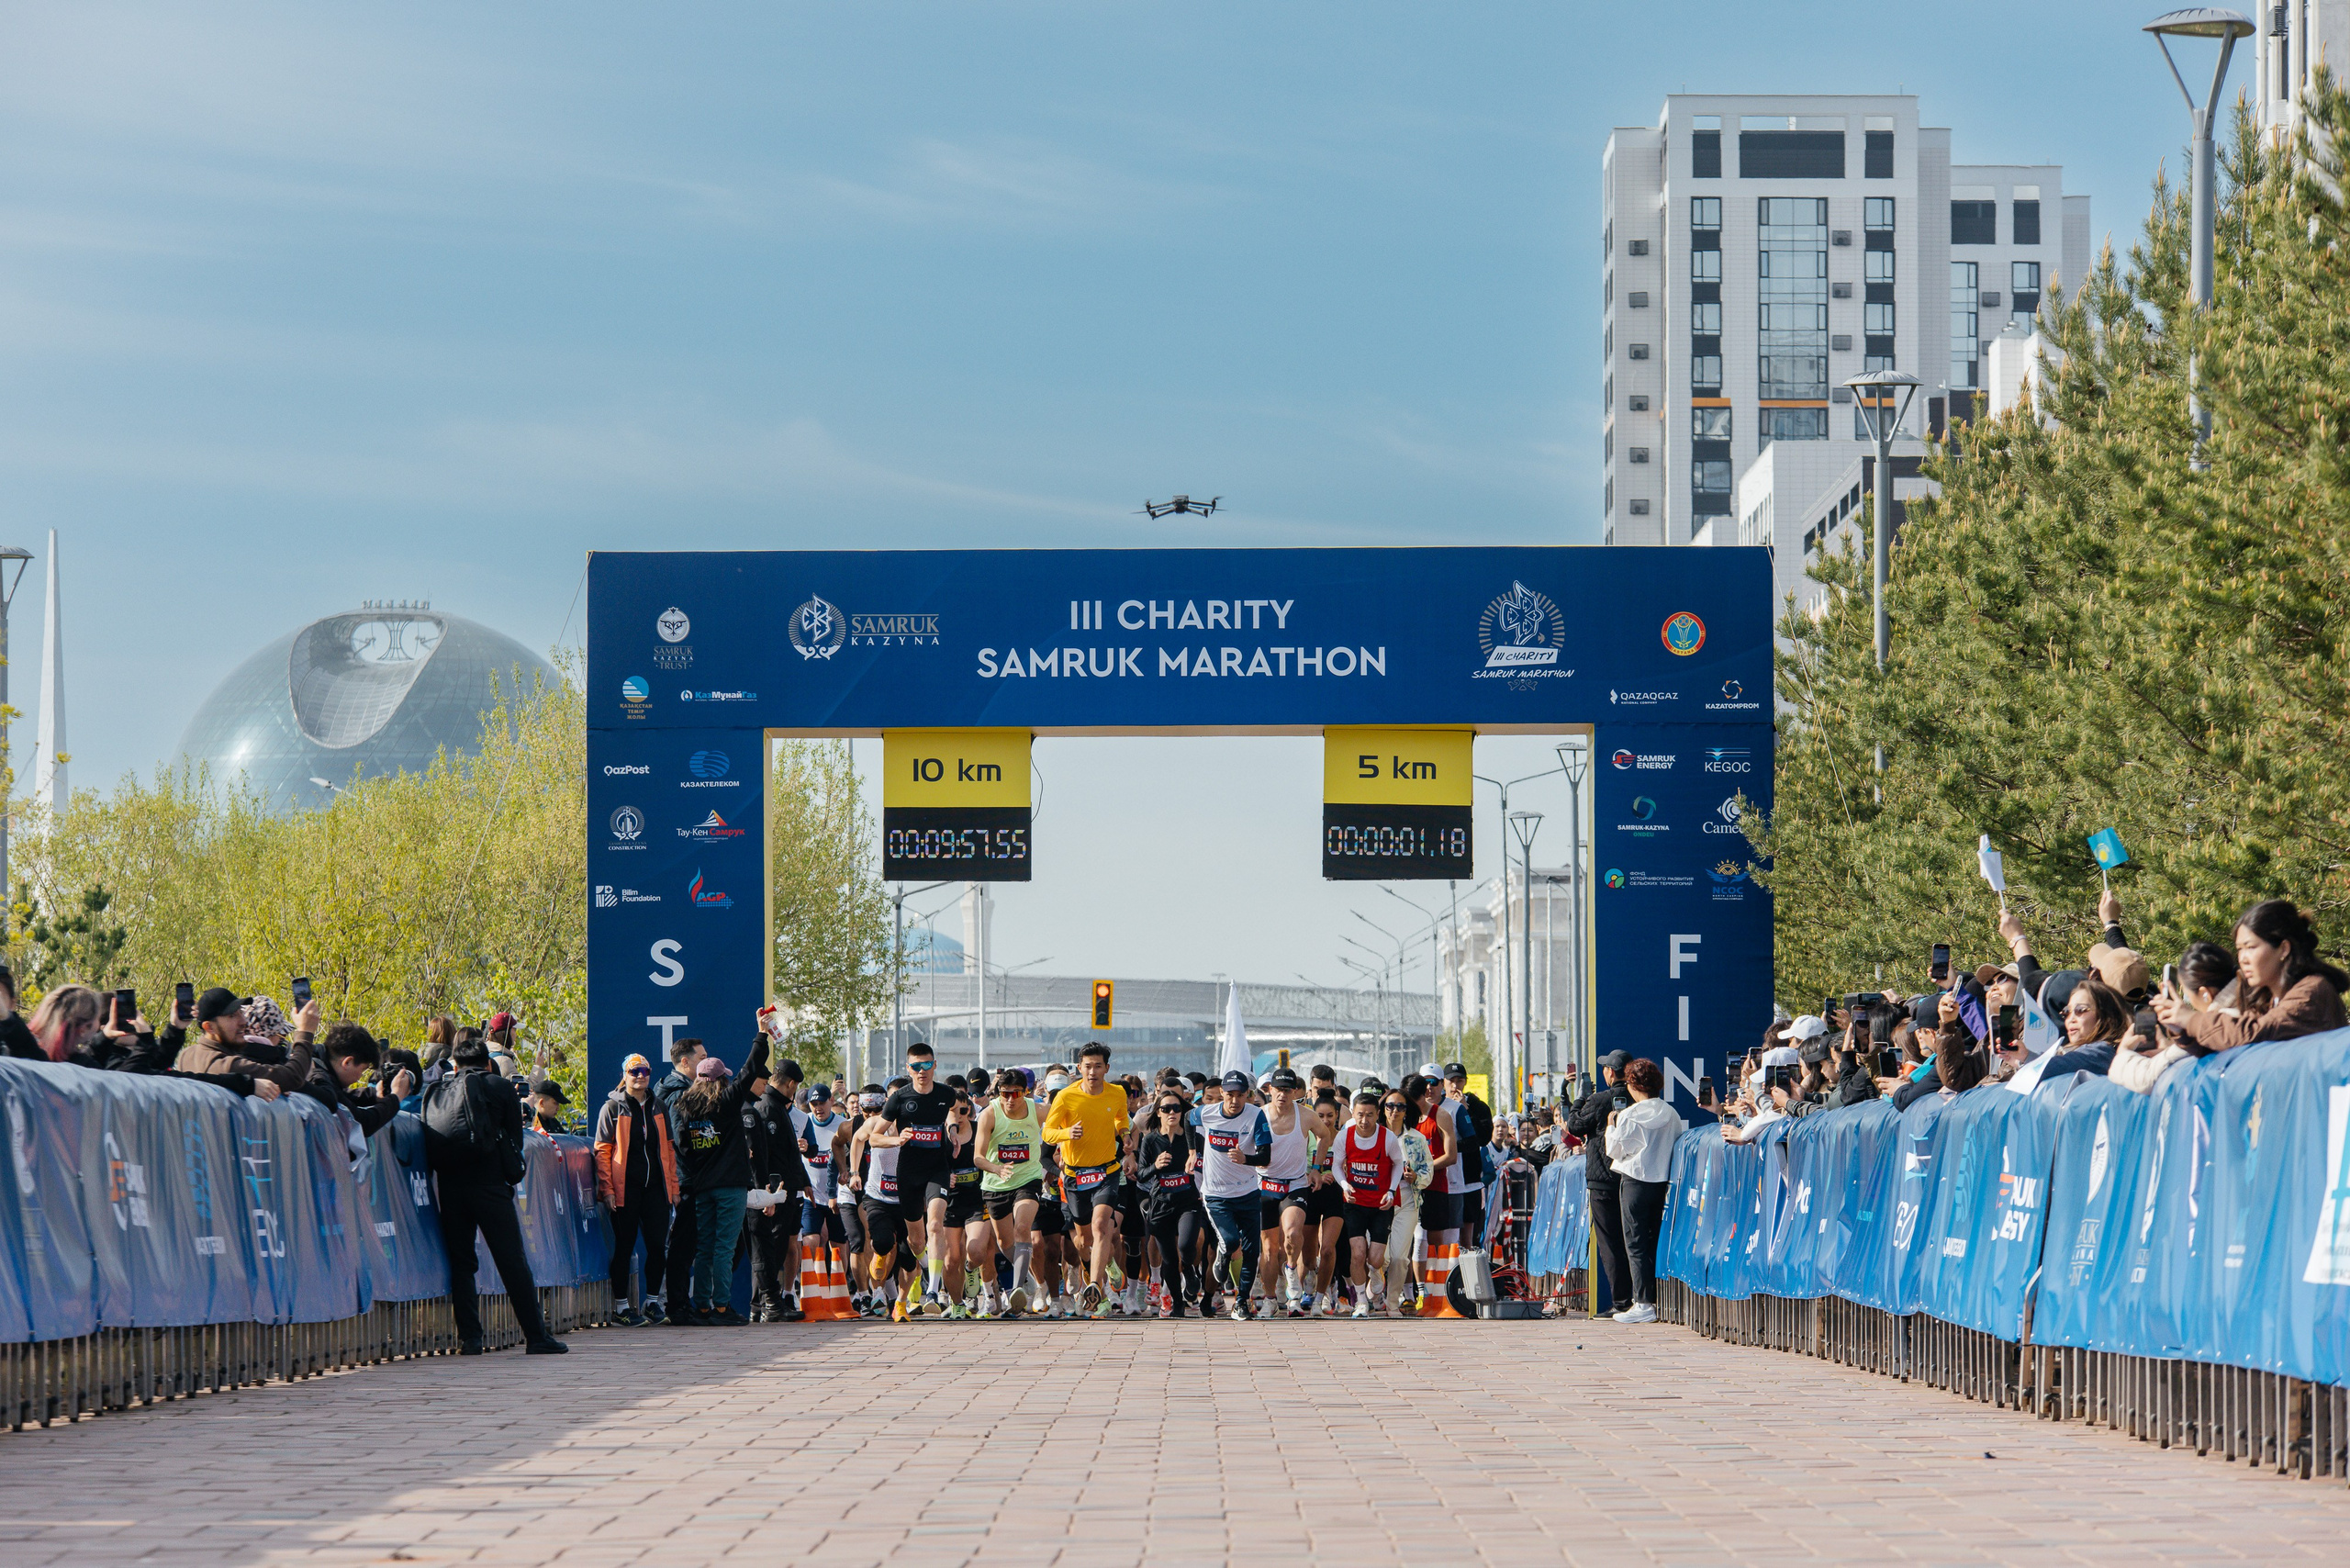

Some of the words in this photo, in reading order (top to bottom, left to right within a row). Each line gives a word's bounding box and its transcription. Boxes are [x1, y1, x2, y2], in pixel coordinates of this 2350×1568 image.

[1070, 600, 1102, 630] III
[1117, 599, 1294, 630] CHARITY
[852, 617, 939, 633] SAMRUK
[851, 636, 939, 645] KAZYNA
[654, 647, 693, 655] SAMRUK
[1505, 651, 1554, 661] CHARITY
[977, 647, 1145, 678] SAMRUK
[1158, 646, 1386, 678] MARATHON
[1472, 669, 1517, 678] SAMRUK
[1516, 669, 1575, 678] MARATHON
[1620, 692, 1679, 700] QAZAQGAZ
[604, 765, 650, 776] QazPost
[913, 758, 944, 782] 10
[958, 758, 1002, 782] km
[1359, 755, 1380, 778] 5
[1393, 756, 1437, 779] km
[1705, 762, 1751, 773] KEGOC
[676, 828, 708, 838] Тау-Кен
[709, 828, 745, 837] Самрук
[889, 829, 1027, 859] 00:09:57.55
[1328, 826, 1465, 857] 00:00:01.18
[915, 1132, 931, 1141] 002
[1212, 1137, 1226, 1145] 059
[692, 1135, 720, 1149] TEAM
[1367, 1162, 1378, 1171] KZ
[1080, 1175, 1096, 1183] 076
[1354, 1176, 1367, 1184] 007
